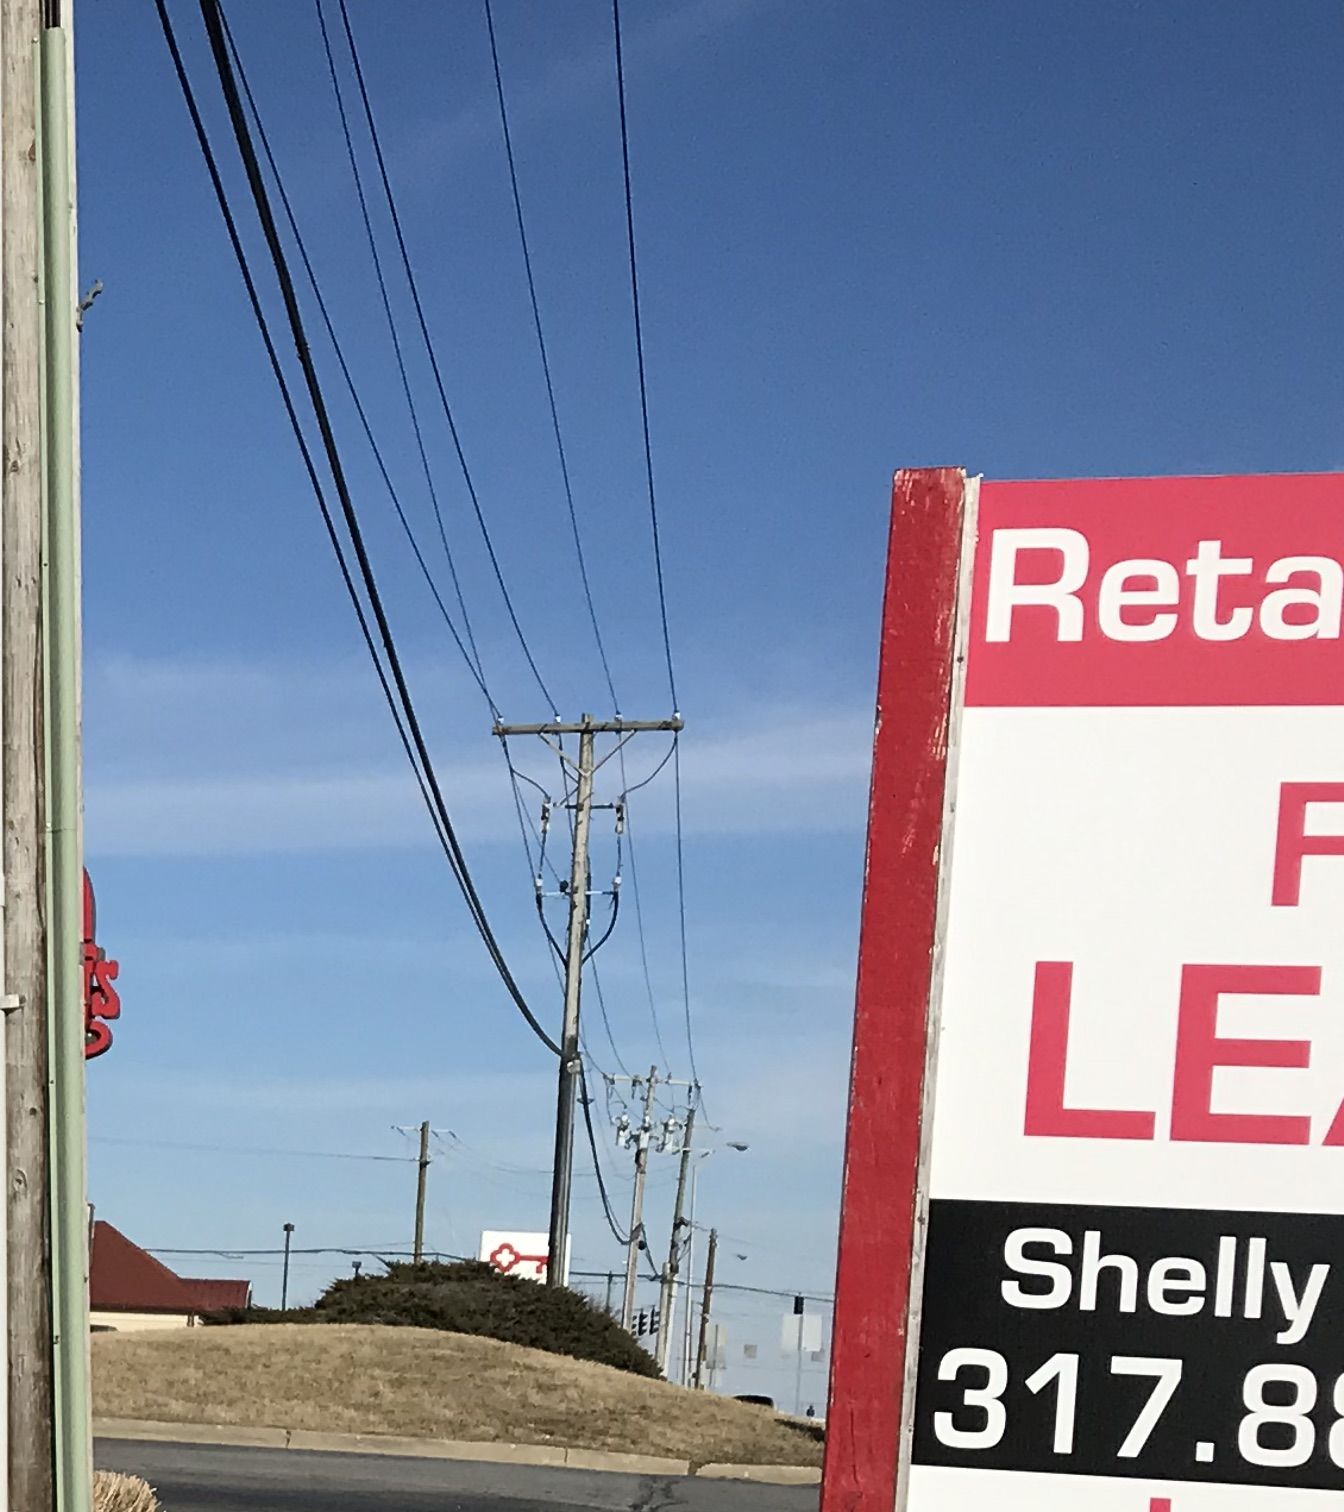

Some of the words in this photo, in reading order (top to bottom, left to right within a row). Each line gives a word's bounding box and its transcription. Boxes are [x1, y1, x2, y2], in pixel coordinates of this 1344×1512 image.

[984, 527, 1344, 642] Reta
[1023, 961, 1344, 1145] LE
[1000, 1228, 1329, 1345] Shelly
[932, 1347, 1344, 1468] 317.8
